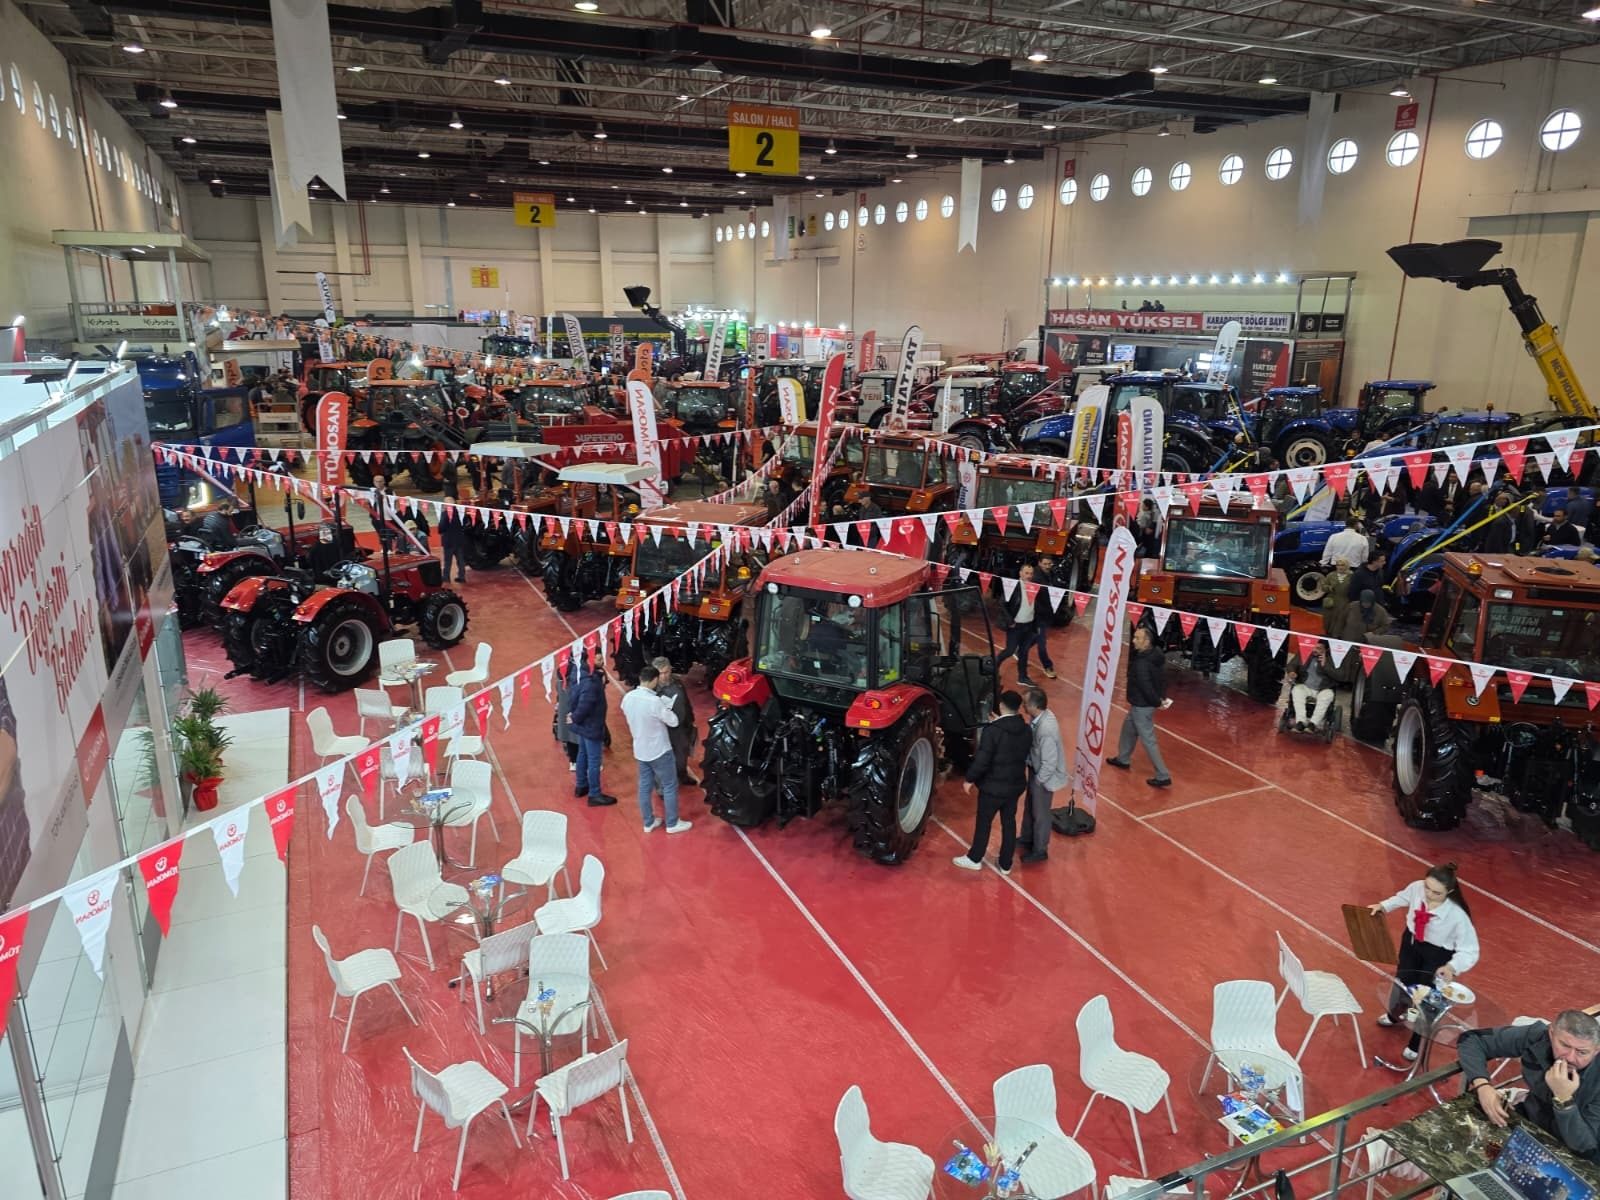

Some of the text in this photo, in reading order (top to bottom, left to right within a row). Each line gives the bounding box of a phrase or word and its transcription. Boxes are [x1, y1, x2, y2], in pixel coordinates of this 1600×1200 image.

[732, 111, 763, 125] SALON
[771, 115, 795, 127] HALL
[755, 131, 774, 167] 2
[530, 205, 541, 224] 2
[1052, 313, 1111, 326] HASAN
[1117, 313, 1198, 328] YÜKSEL
[897, 336, 918, 415] HATTAT
[1551, 359, 1565, 378] NEW
[325, 401, 341, 481] TÜMOSAN
